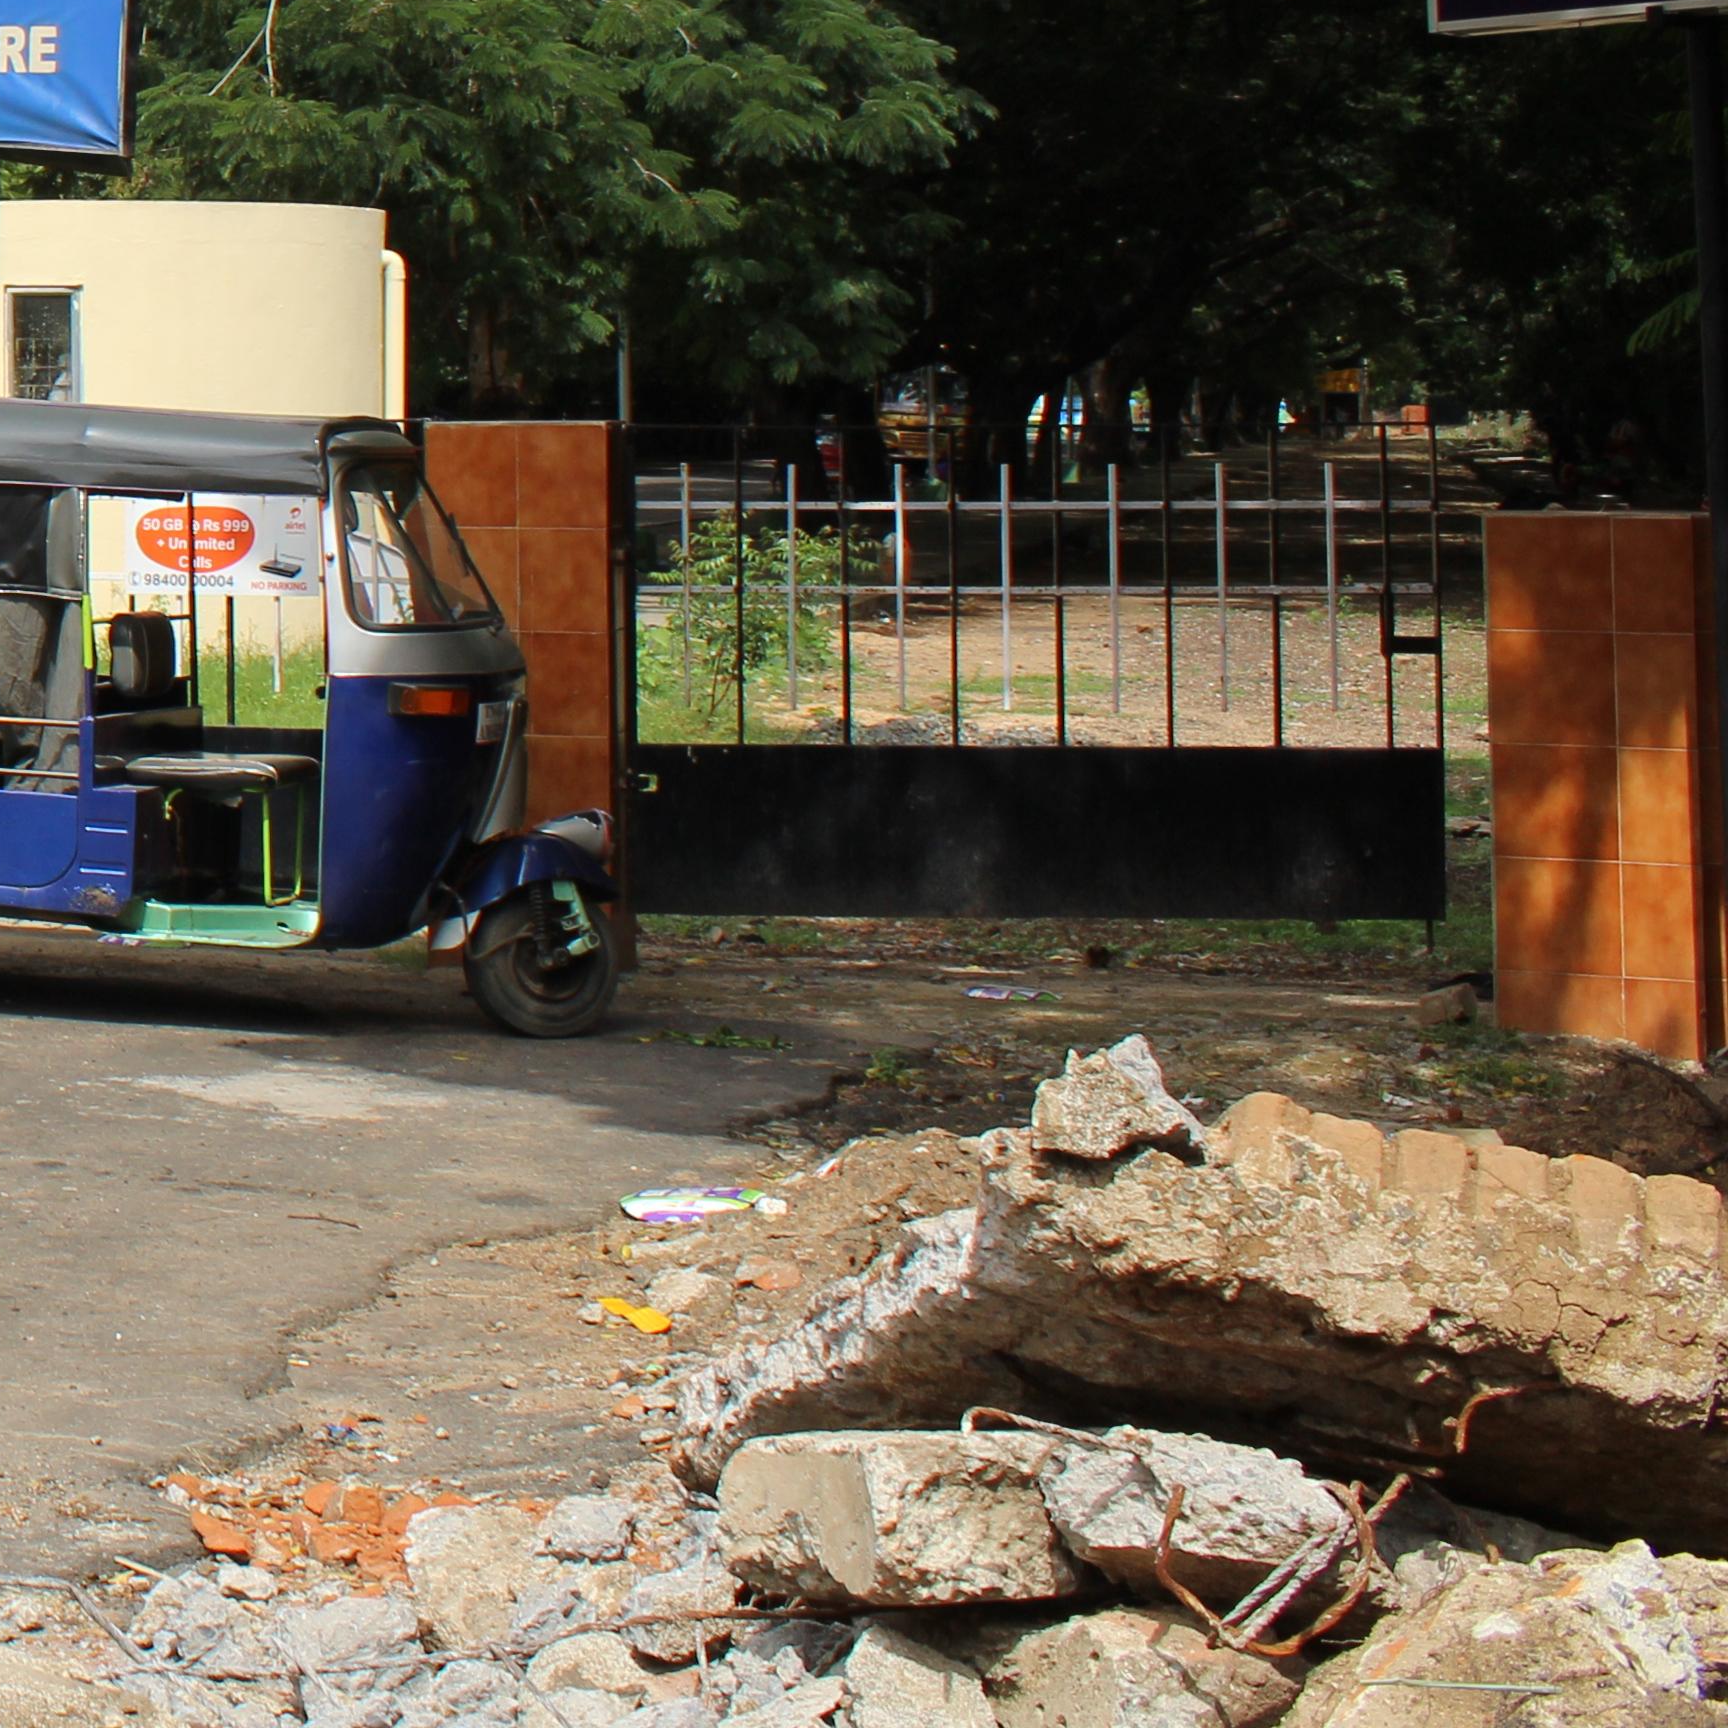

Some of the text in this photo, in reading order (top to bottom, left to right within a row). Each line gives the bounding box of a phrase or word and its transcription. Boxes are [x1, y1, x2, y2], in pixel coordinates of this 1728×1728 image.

[142, 518, 161, 531] 50
[163, 518, 184, 532] GB
[203, 519, 220, 532] Rs
[223, 520, 250, 532] 999
[285, 520, 307, 530] airtel
[157, 536, 235, 551] + Unmited
[144, 574, 187, 586] 98400
[251, 581, 308, 592] NO PARKING
